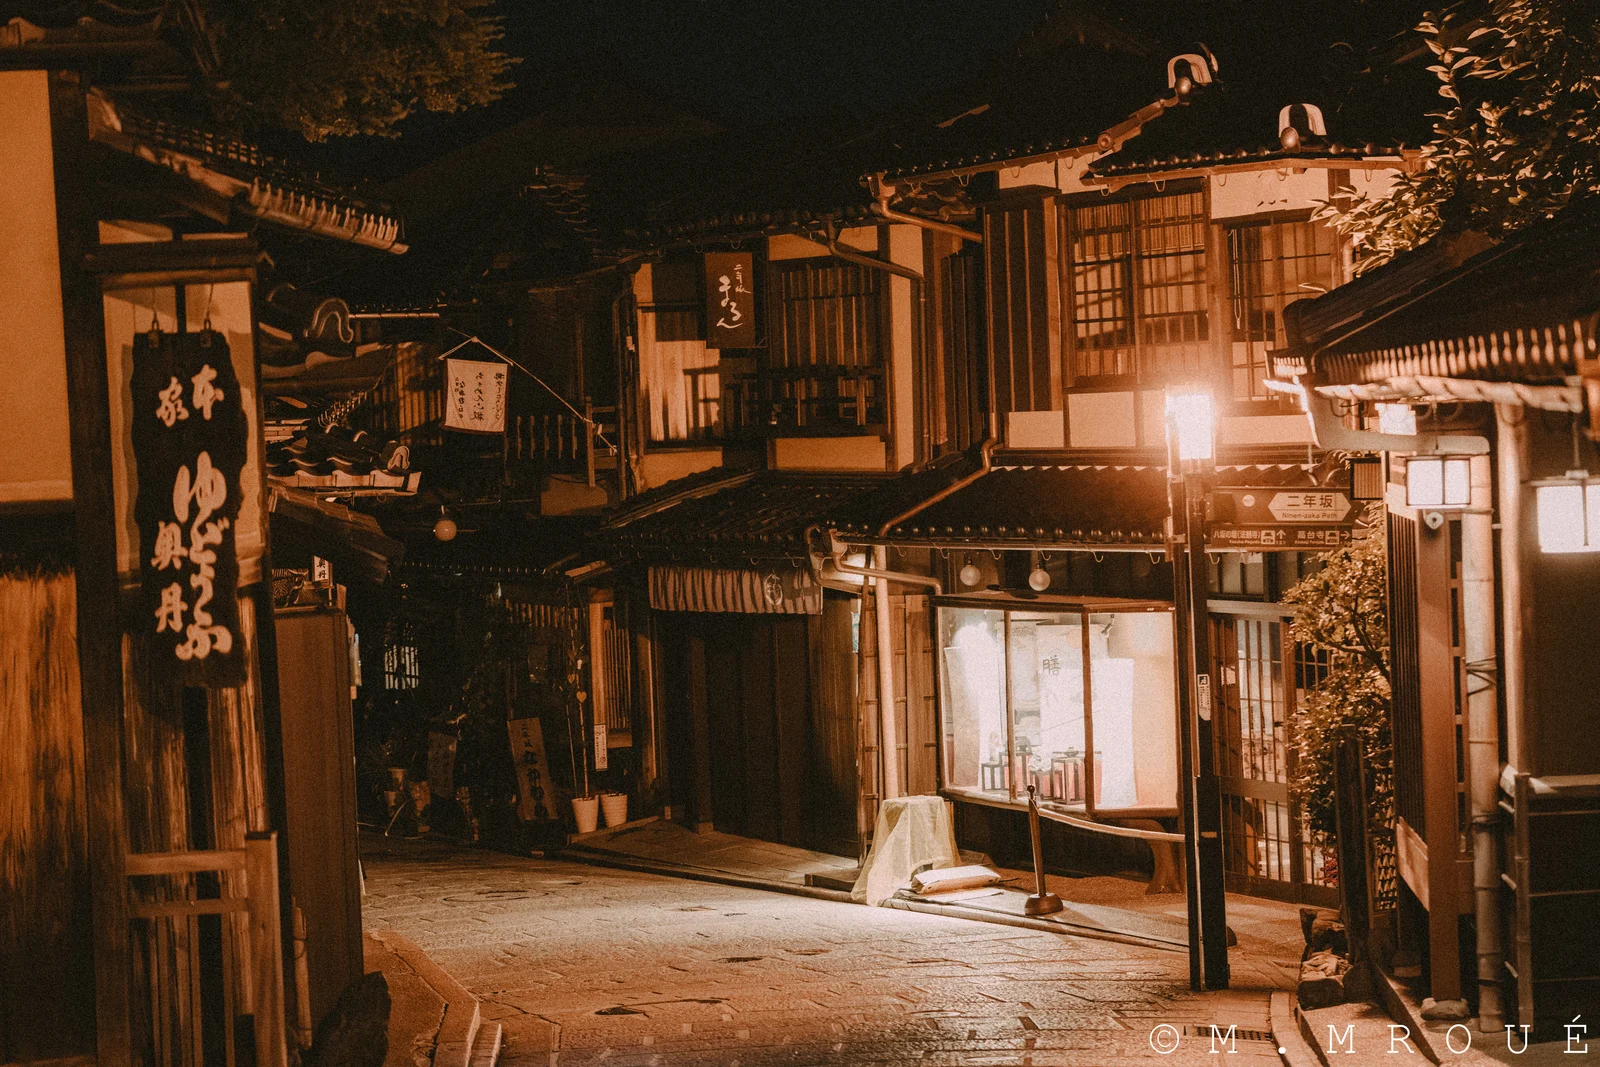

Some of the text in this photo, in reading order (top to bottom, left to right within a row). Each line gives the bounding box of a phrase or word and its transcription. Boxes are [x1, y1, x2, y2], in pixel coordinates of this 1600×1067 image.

[1287, 494, 1333, 508] 二年坂
[1297, 530, 1324, 539] 高台寺
[150, 520, 188, 633] 奥丹
